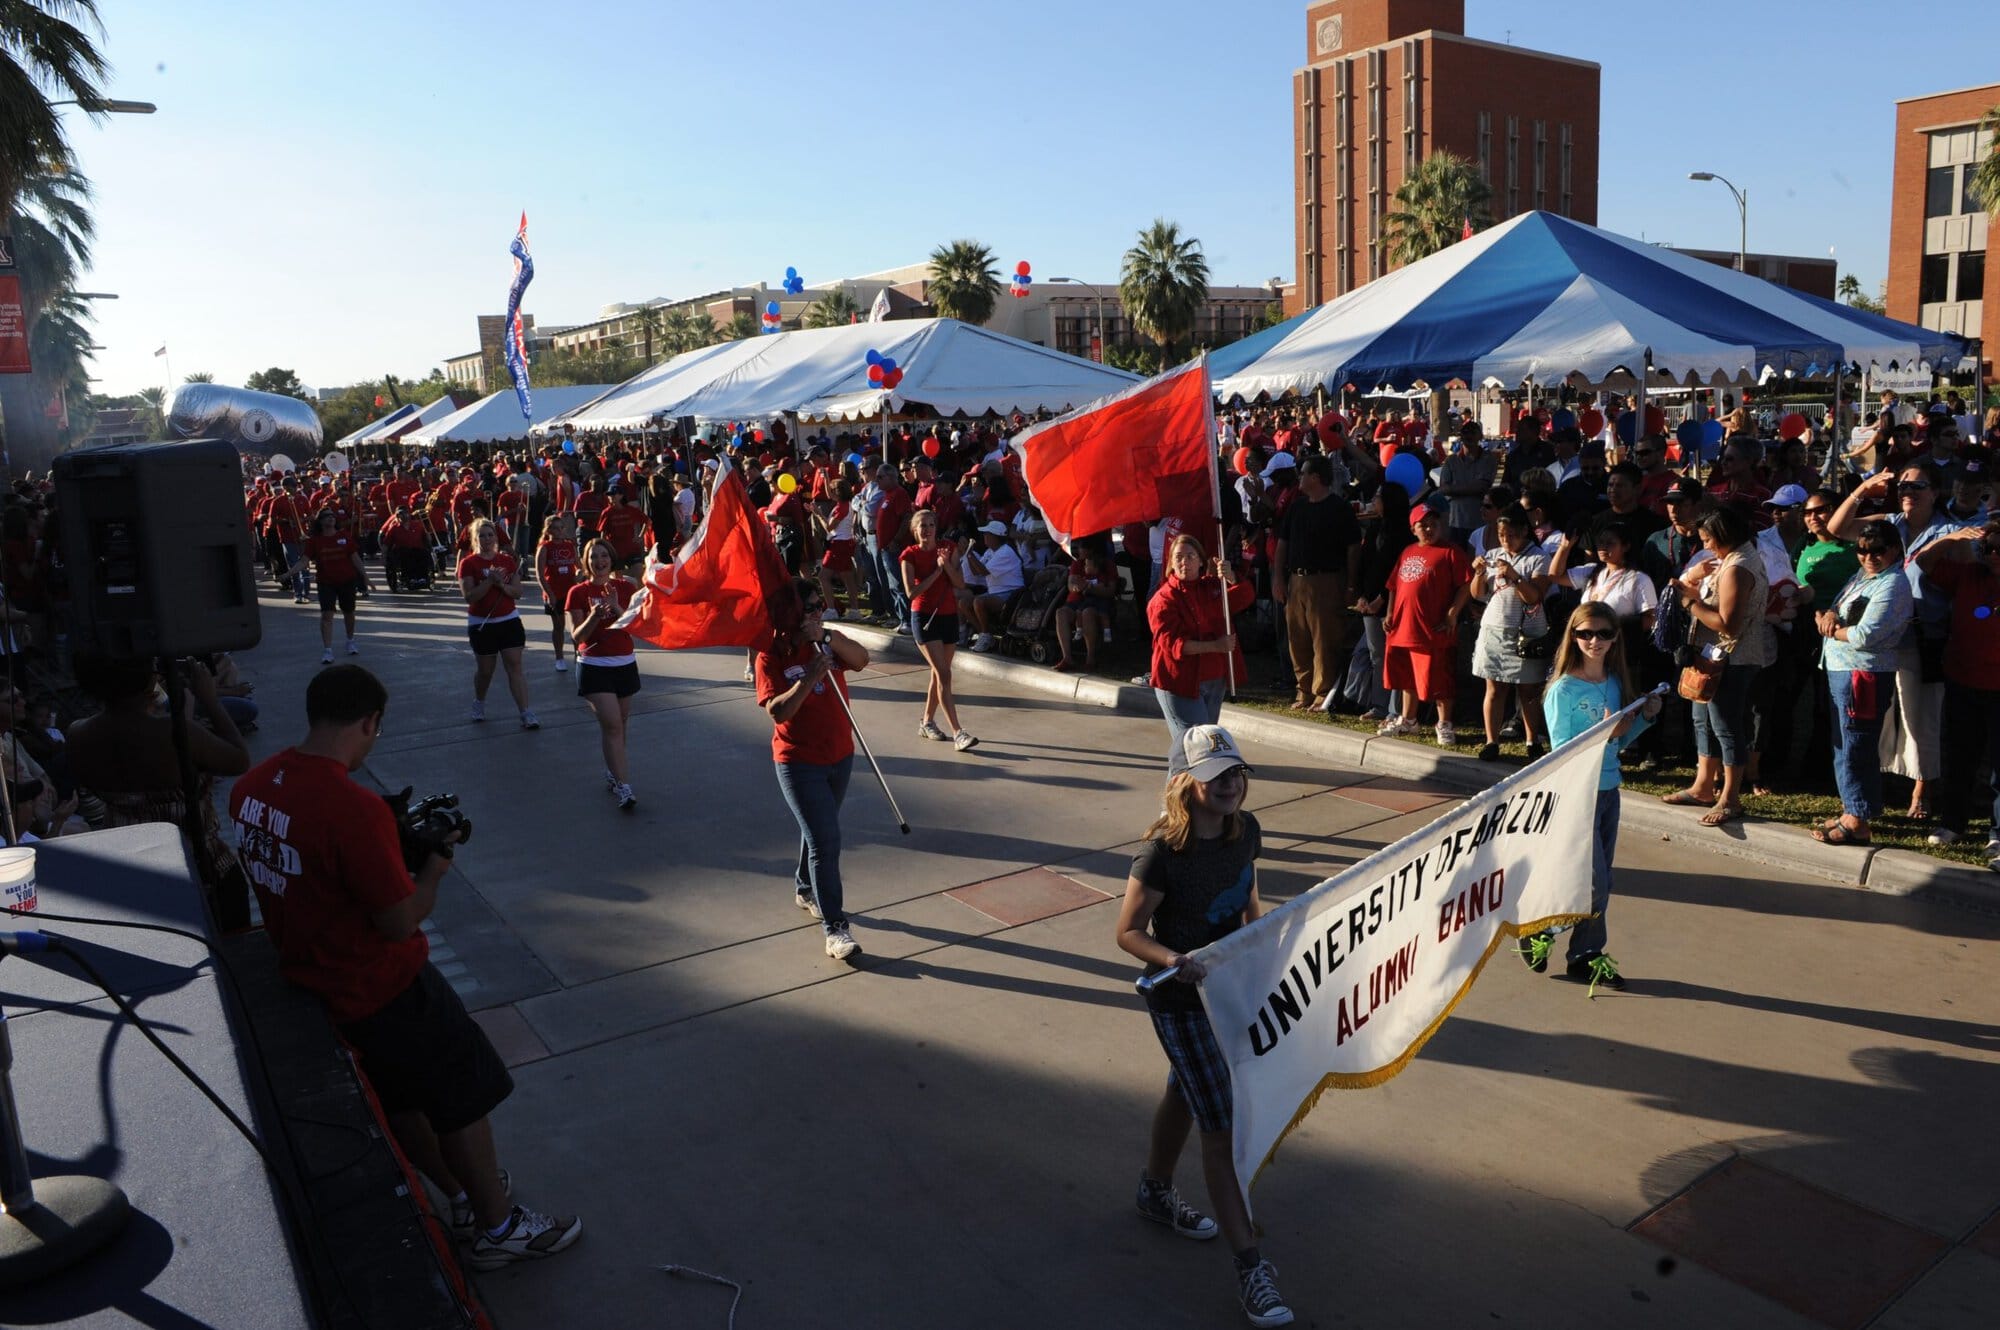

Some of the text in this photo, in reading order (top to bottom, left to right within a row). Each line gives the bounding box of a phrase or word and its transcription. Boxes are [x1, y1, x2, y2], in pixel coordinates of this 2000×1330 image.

[1209, 733, 1232, 752] A
[238, 795, 291, 840] ARE YOU
[5, 884, 21, 895] HAVE
[16, 888, 33, 902] YOU
[1248, 790, 1560, 1057] UNIVERSITY OF ARIZON
[1336, 868, 1505, 1047] ALUMNI BAND
